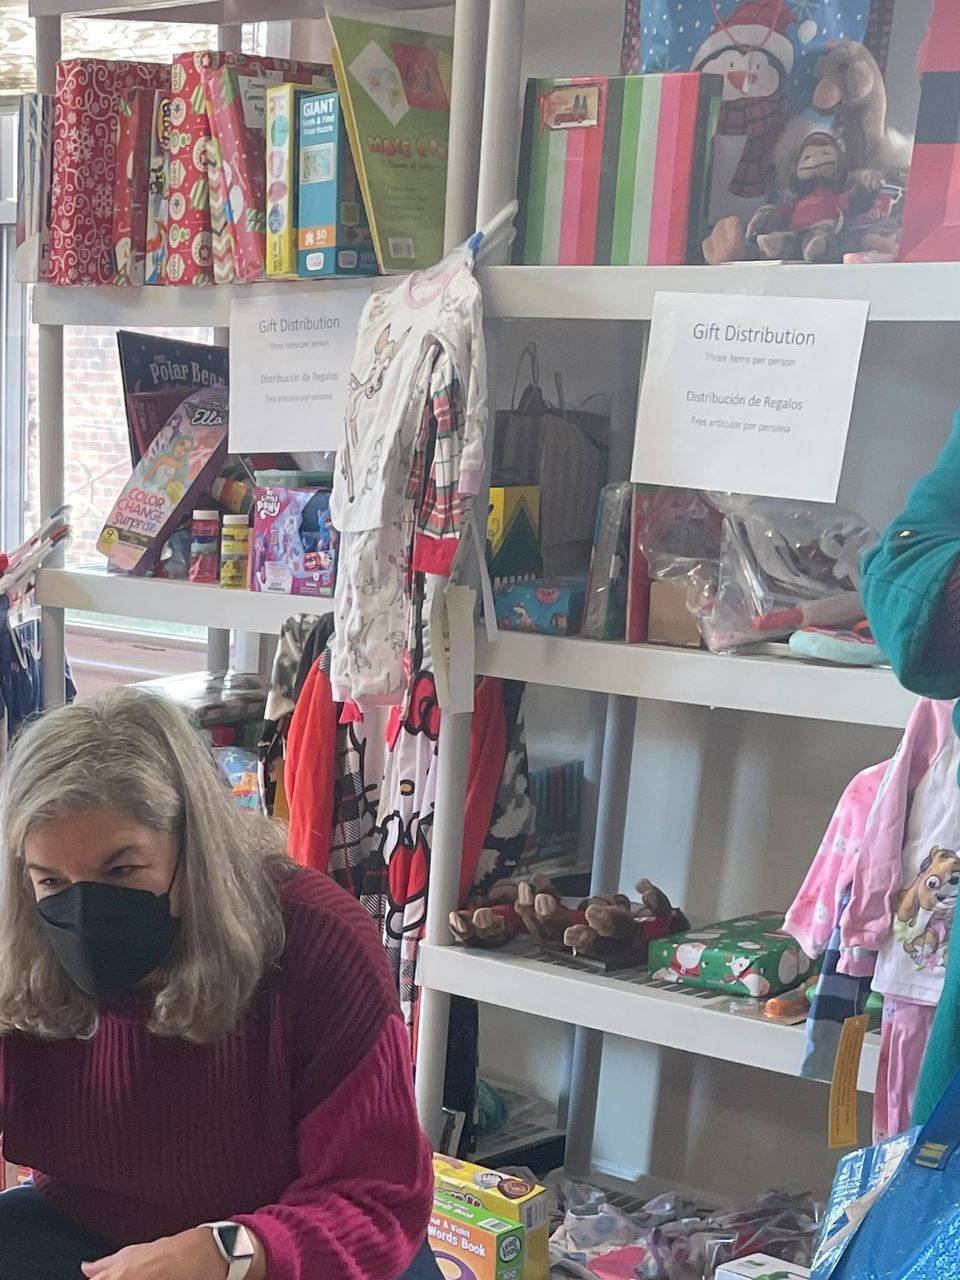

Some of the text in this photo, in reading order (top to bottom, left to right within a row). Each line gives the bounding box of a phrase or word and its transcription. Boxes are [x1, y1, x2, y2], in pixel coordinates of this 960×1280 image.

[303, 98, 335, 117] GIANT
[322, 115, 336, 124] Find
[258, 314, 340, 334] Gift Distribution
[692, 322, 816, 347] Gift Distribution
[704, 352, 797, 368] Three items per person
[148, 360, 189, 385] Polar
[312, 371, 339, 383] Regalos
[686, 390, 804, 413] Distribución de Regalos
[190, 408, 224, 427] Ella
[741, 421, 758, 433] por
[757, 423, 792, 435] persona
[128, 487, 166, 510] COLOR
[116, 496, 165, 524] CHANGE
[111, 510, 158, 535] Surprise
[428, 1225, 487, 1258] Words Book
